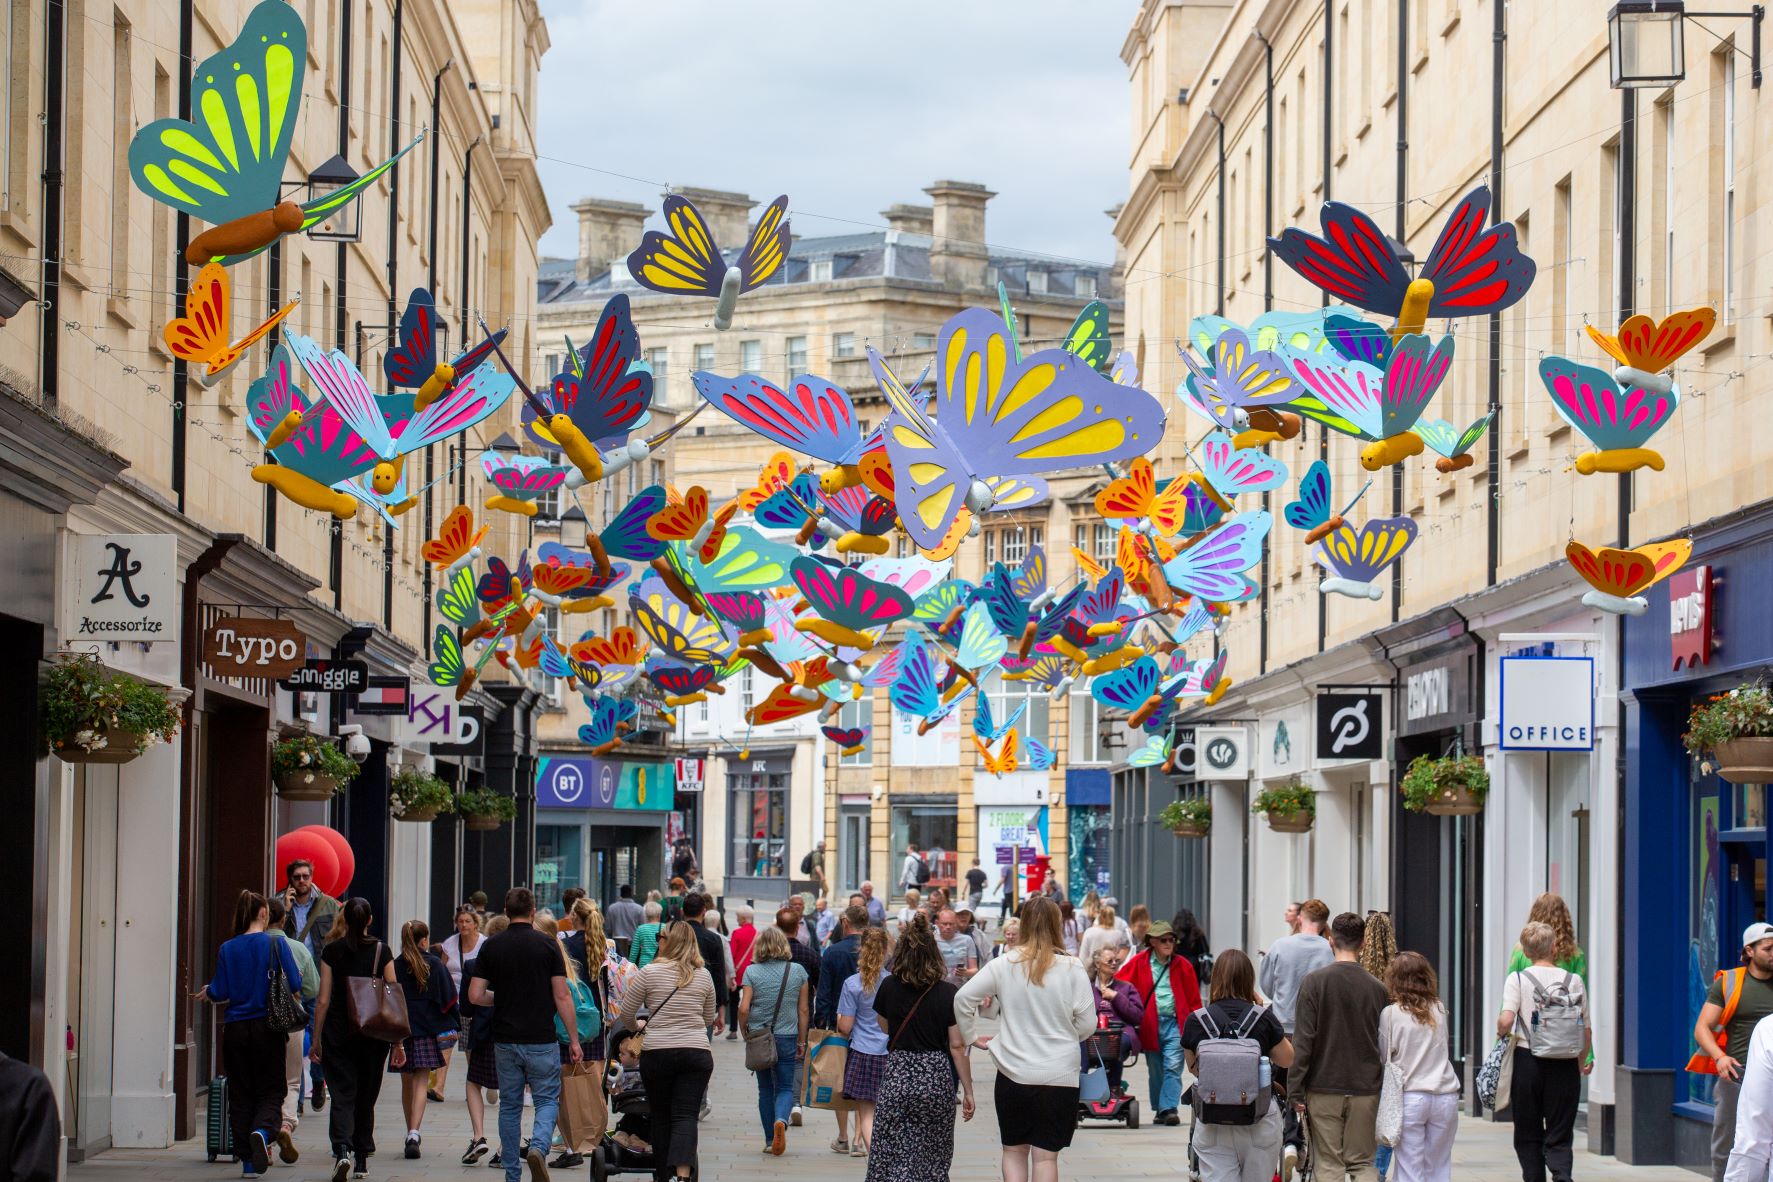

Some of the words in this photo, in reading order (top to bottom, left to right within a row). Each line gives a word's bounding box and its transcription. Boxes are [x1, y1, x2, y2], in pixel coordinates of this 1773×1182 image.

[91, 542, 150, 608] A
[79, 616, 162, 635] Accessorize
[215, 629, 298, 665] Typo
[1509, 726, 1587, 741] OFFICE
[752, 760, 767, 772] KFC
[559, 775, 577, 791] BT
[602, 776, 611, 792] BT
[681, 782, 699, 790] KFC
